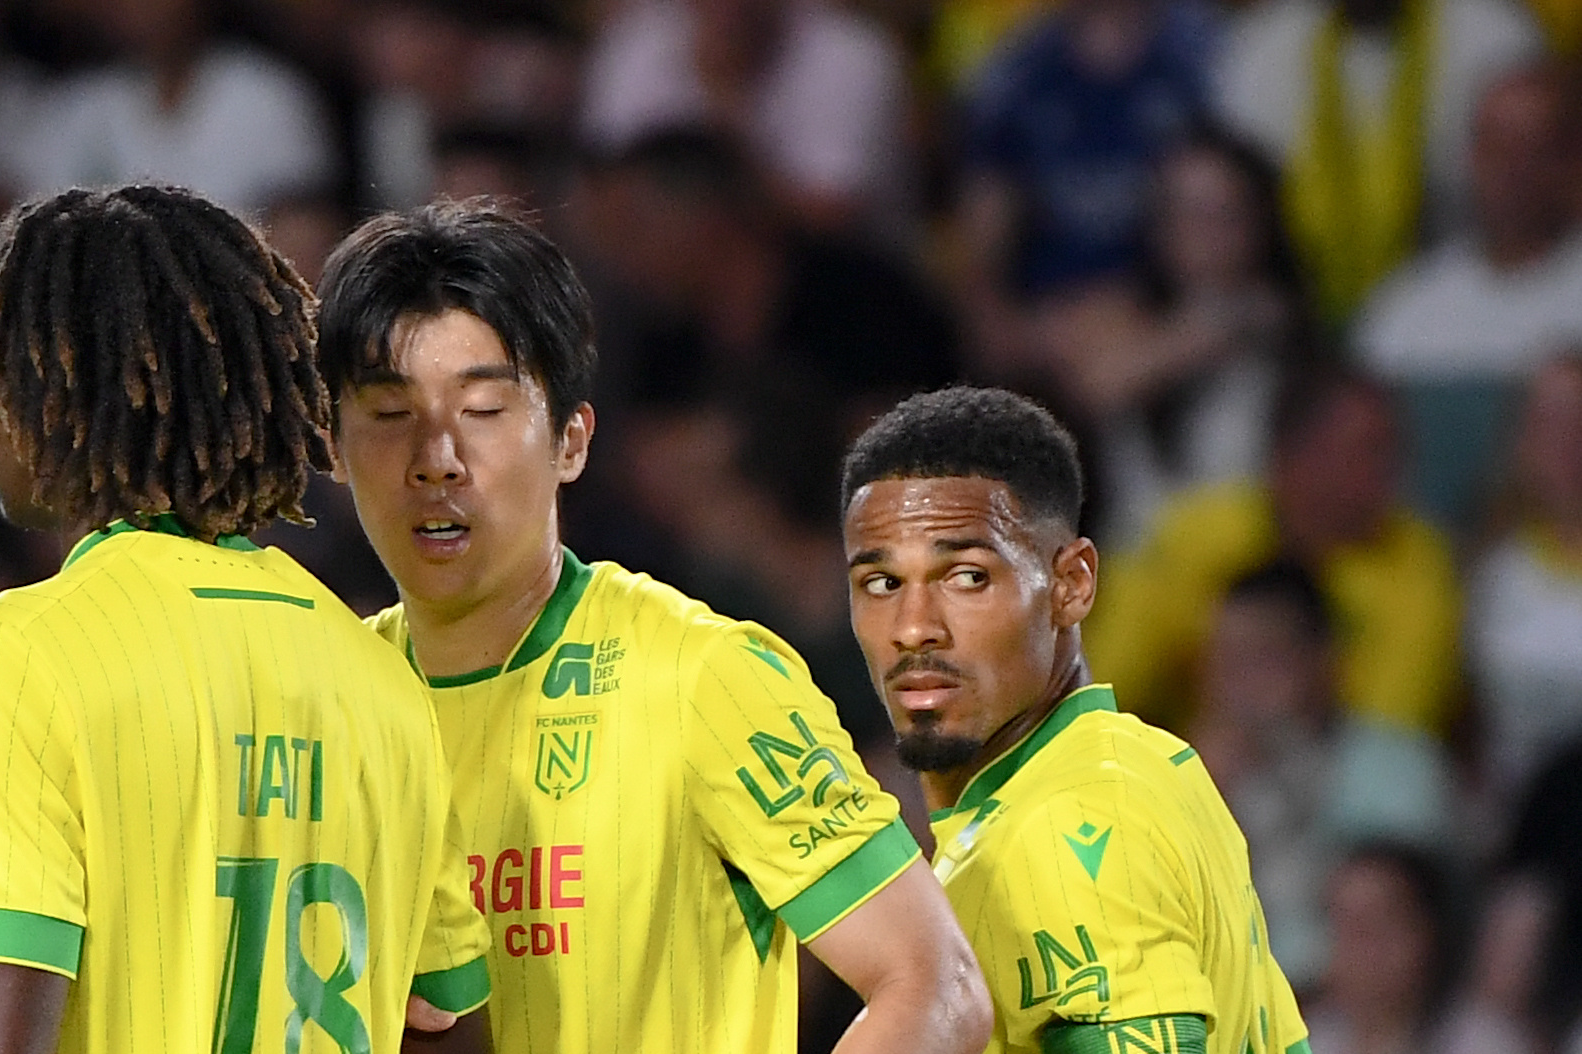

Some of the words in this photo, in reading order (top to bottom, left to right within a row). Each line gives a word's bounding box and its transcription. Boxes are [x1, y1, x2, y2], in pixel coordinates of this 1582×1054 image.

[594, 665, 615, 680] DES
[536, 717, 550, 728] FC
[552, 714, 598, 727] NANTES
[234, 733, 322, 822] TATI
[505, 922, 569, 957] CDI
